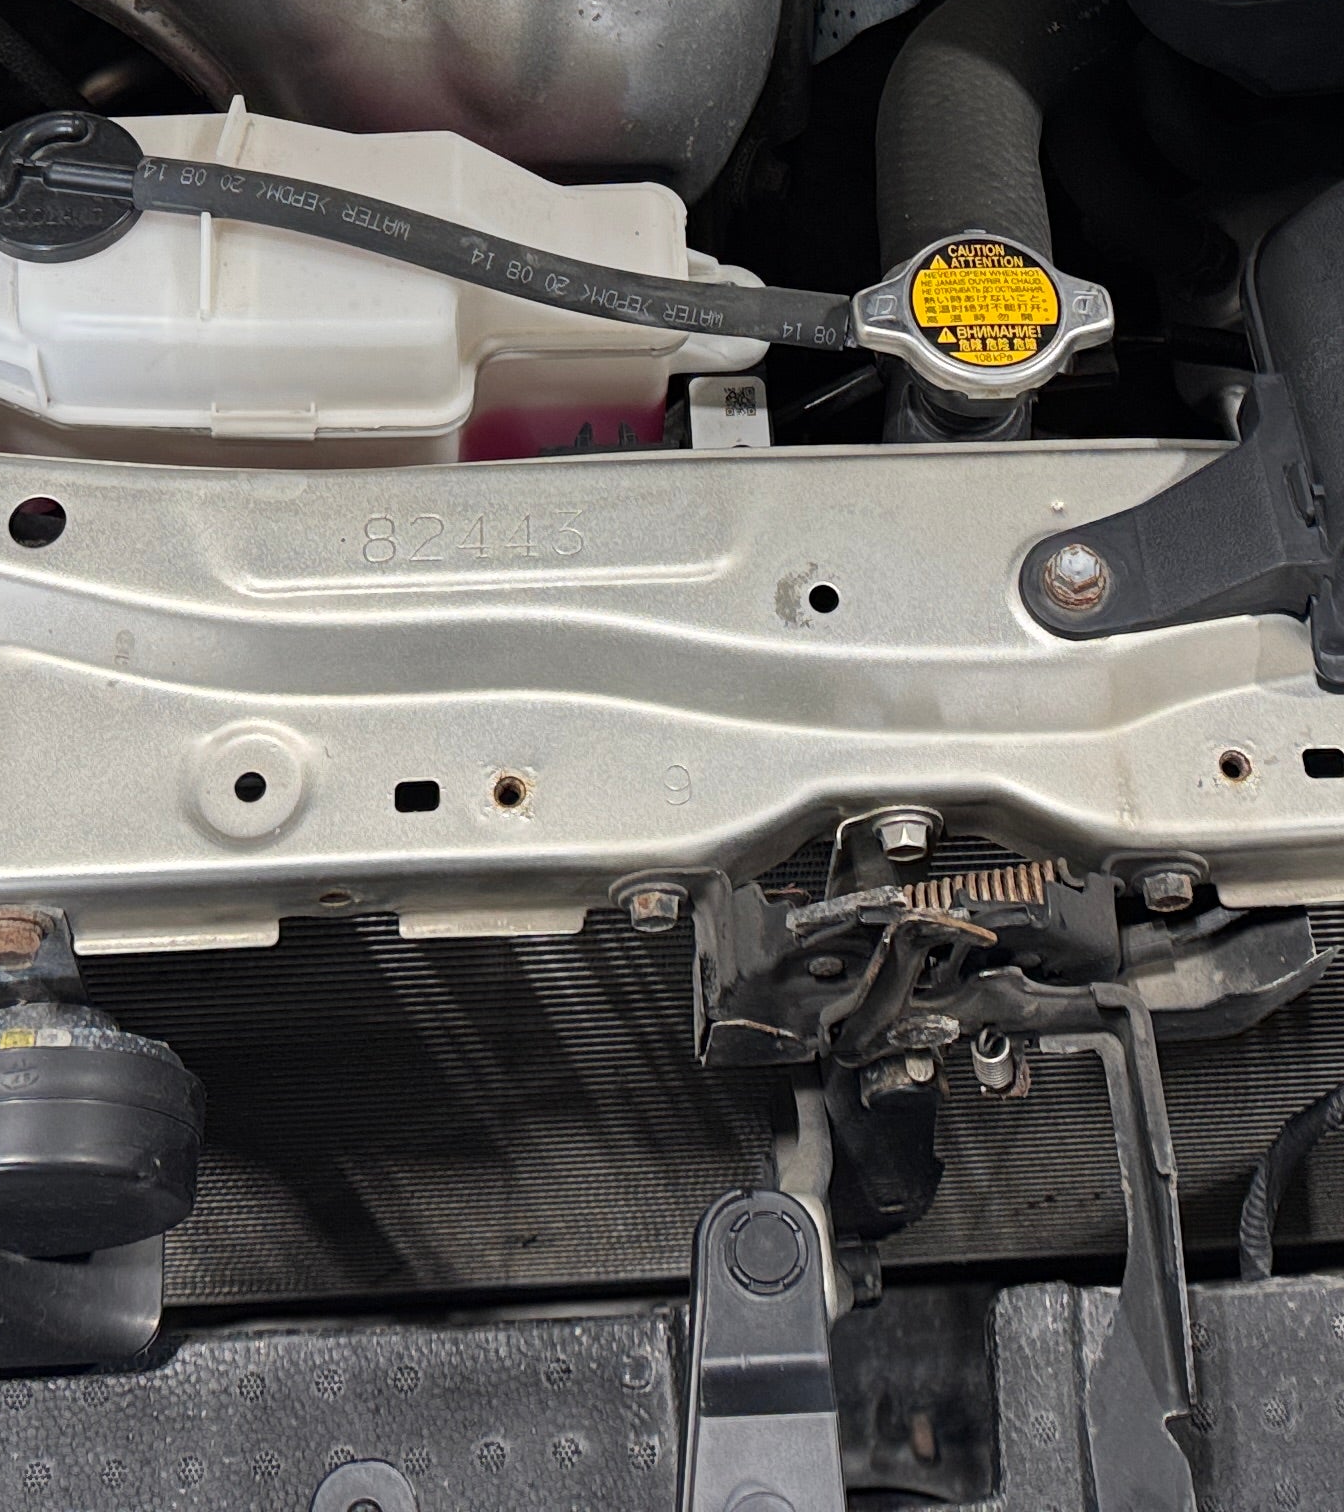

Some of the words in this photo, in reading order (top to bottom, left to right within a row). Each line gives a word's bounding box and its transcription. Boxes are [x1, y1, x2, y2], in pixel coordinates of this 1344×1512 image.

[142, 159, 169, 180] 14
[180, 166, 208, 186] 08
[220, 174, 247, 194] 20
[342, 202, 411, 241] WATER
[470, 247, 497, 271] 14
[947, 243, 1005, 258] CAUTION
[950, 255, 1024, 269] ATTENTION
[507, 262, 535, 286] 08
[920, 279, 933, 287] NE
[935, 278, 966, 287] JAMAIS
[967, 277, 1001, 286] OUVRIR
[923, 270, 957, 279] NEVER
[959, 269, 987, 279] OPEN
[988, 269, 1018, 278] WHEN
[545, 273, 572, 296] 20
[664, 303, 725, 329] WATER
[782, 321, 804, 341] 14
[814, 325, 837, 345] 08
[956, 325, 1042, 339] ВНИМАНИЕ!
[362, 509, 585, 564] 82443
[663, 763, 693, 807] 9
